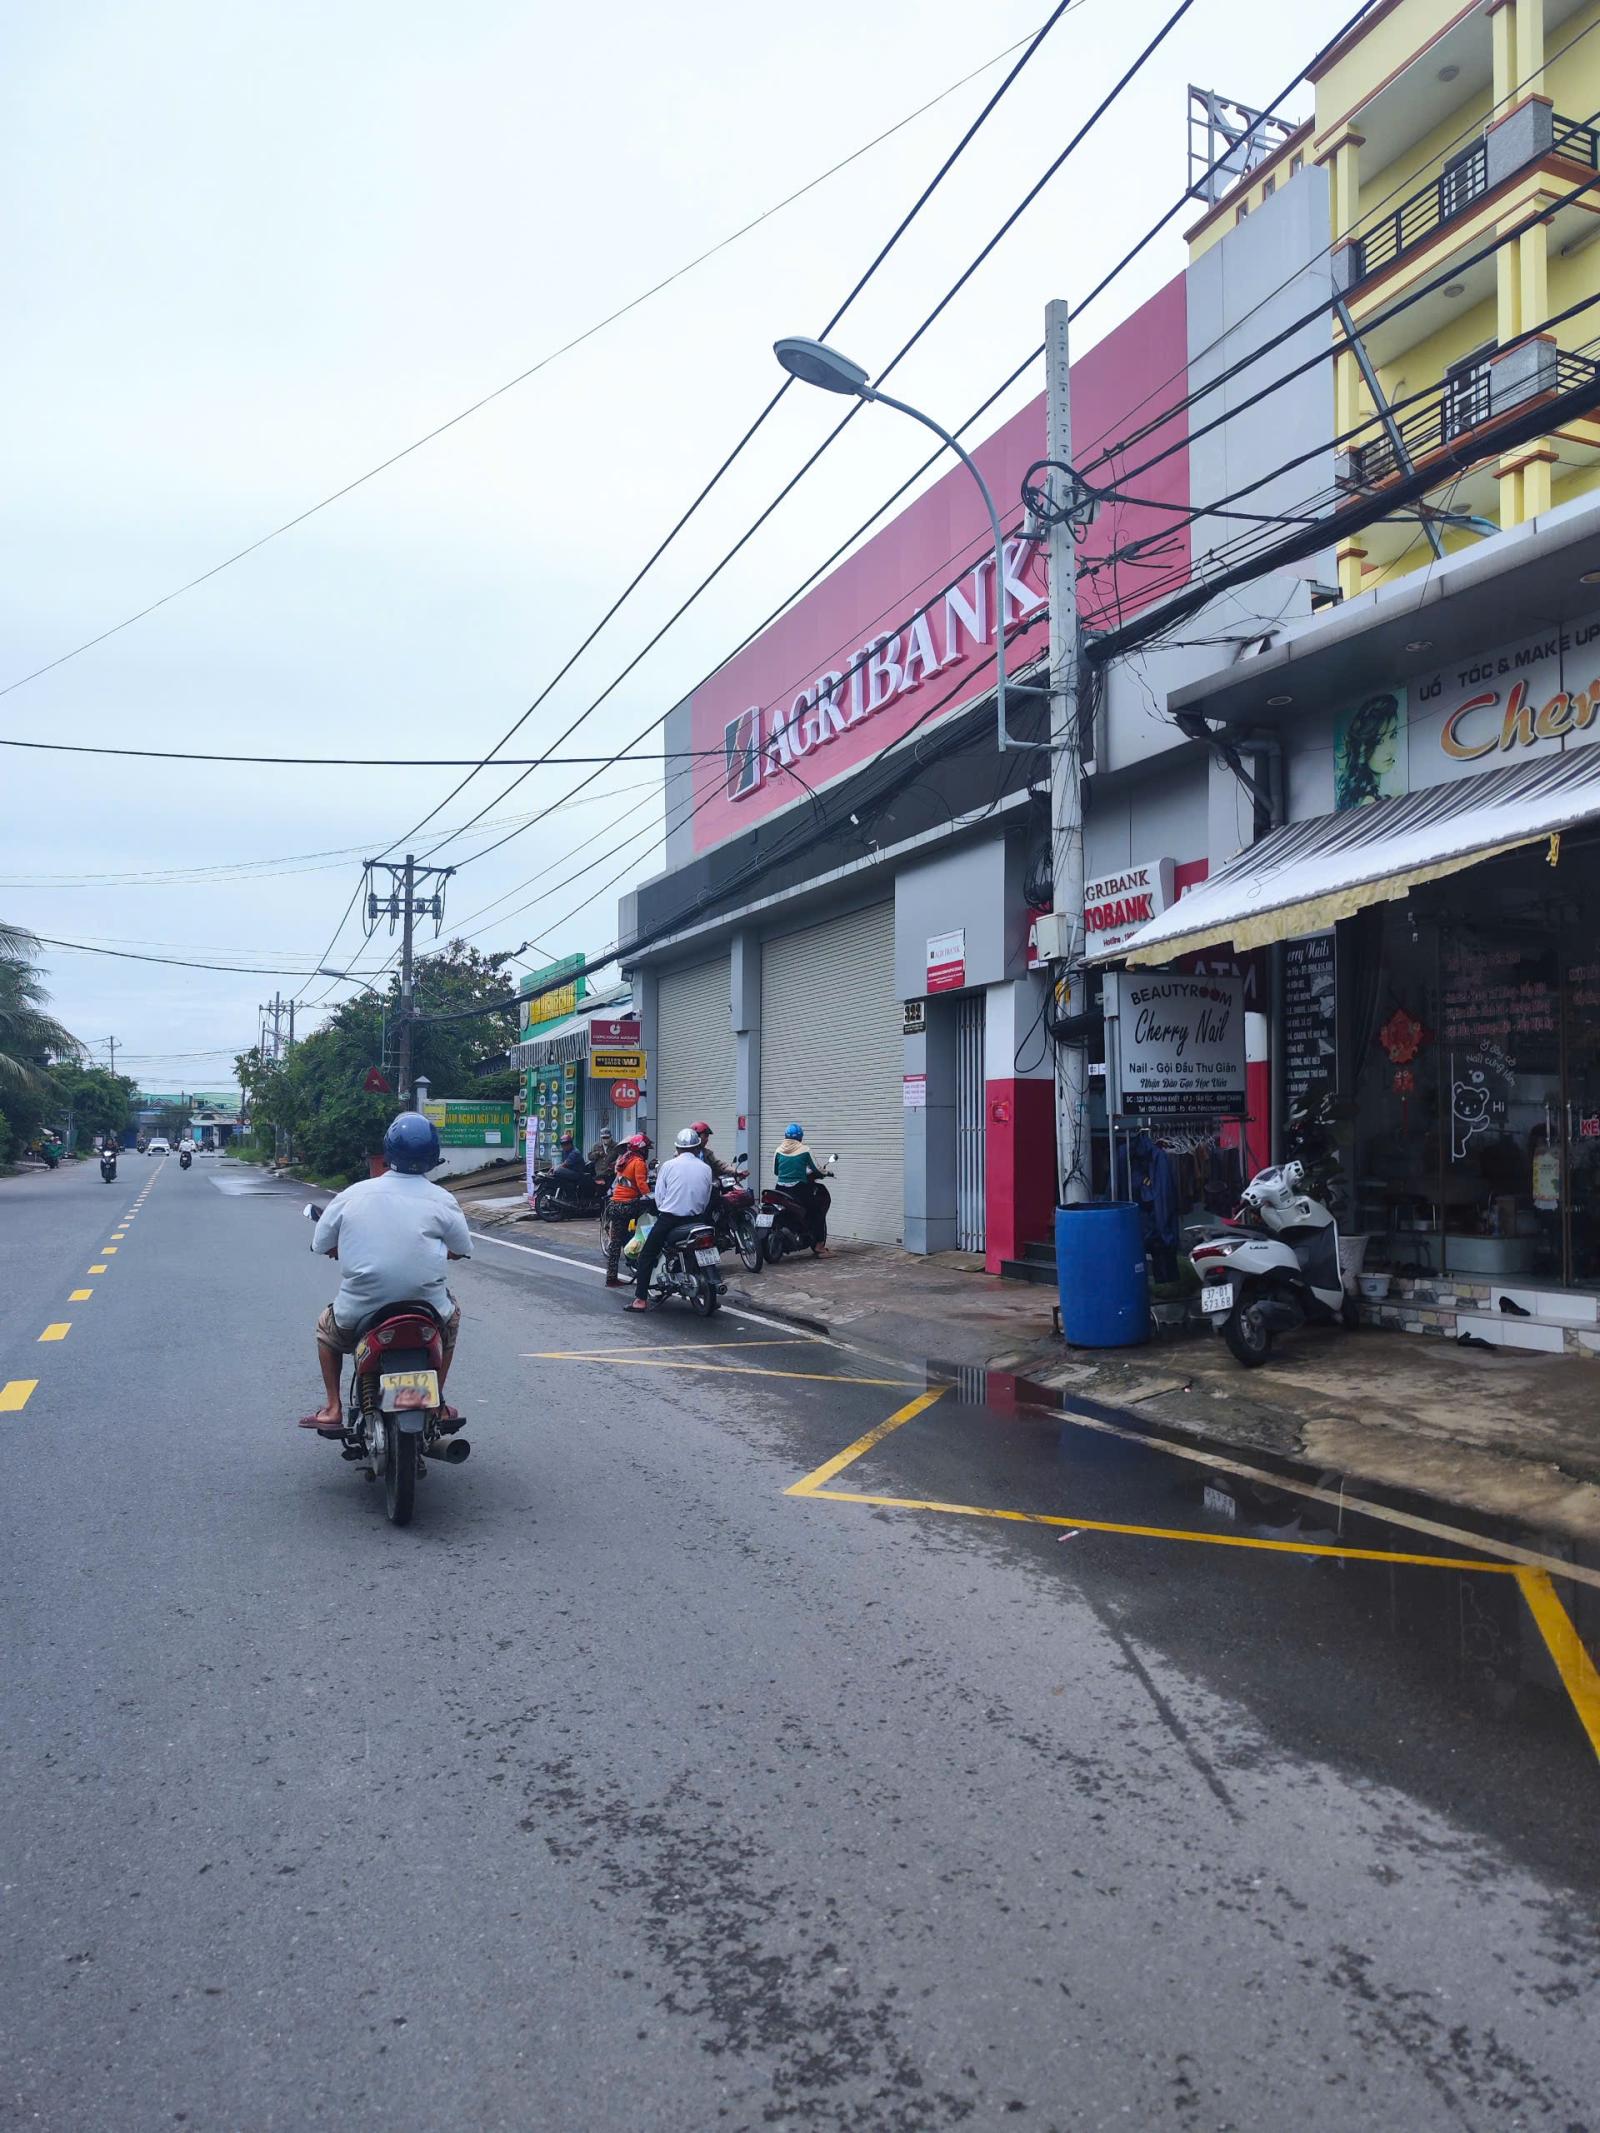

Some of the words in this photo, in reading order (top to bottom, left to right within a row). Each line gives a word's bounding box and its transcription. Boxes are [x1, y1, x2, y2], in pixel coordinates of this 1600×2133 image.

[763, 538, 1050, 778] AGRIBANK
[1457, 663, 1493, 688] TÓC
[1497, 658, 1510, 675] &
[1515, 634, 1570, 668] MAKE
[1575, 622, 1600, 647] UP
[1085, 869, 1150, 902] GRIBANK
[1135, 1008, 1189, 1057] Cherry
[1195, 1007, 1229, 1044] Nail
[1129, 1063, 1148, 1073] Nail
[615, 1084, 636, 1097] ria
[1492, 1101, 1505, 1112] Hi
